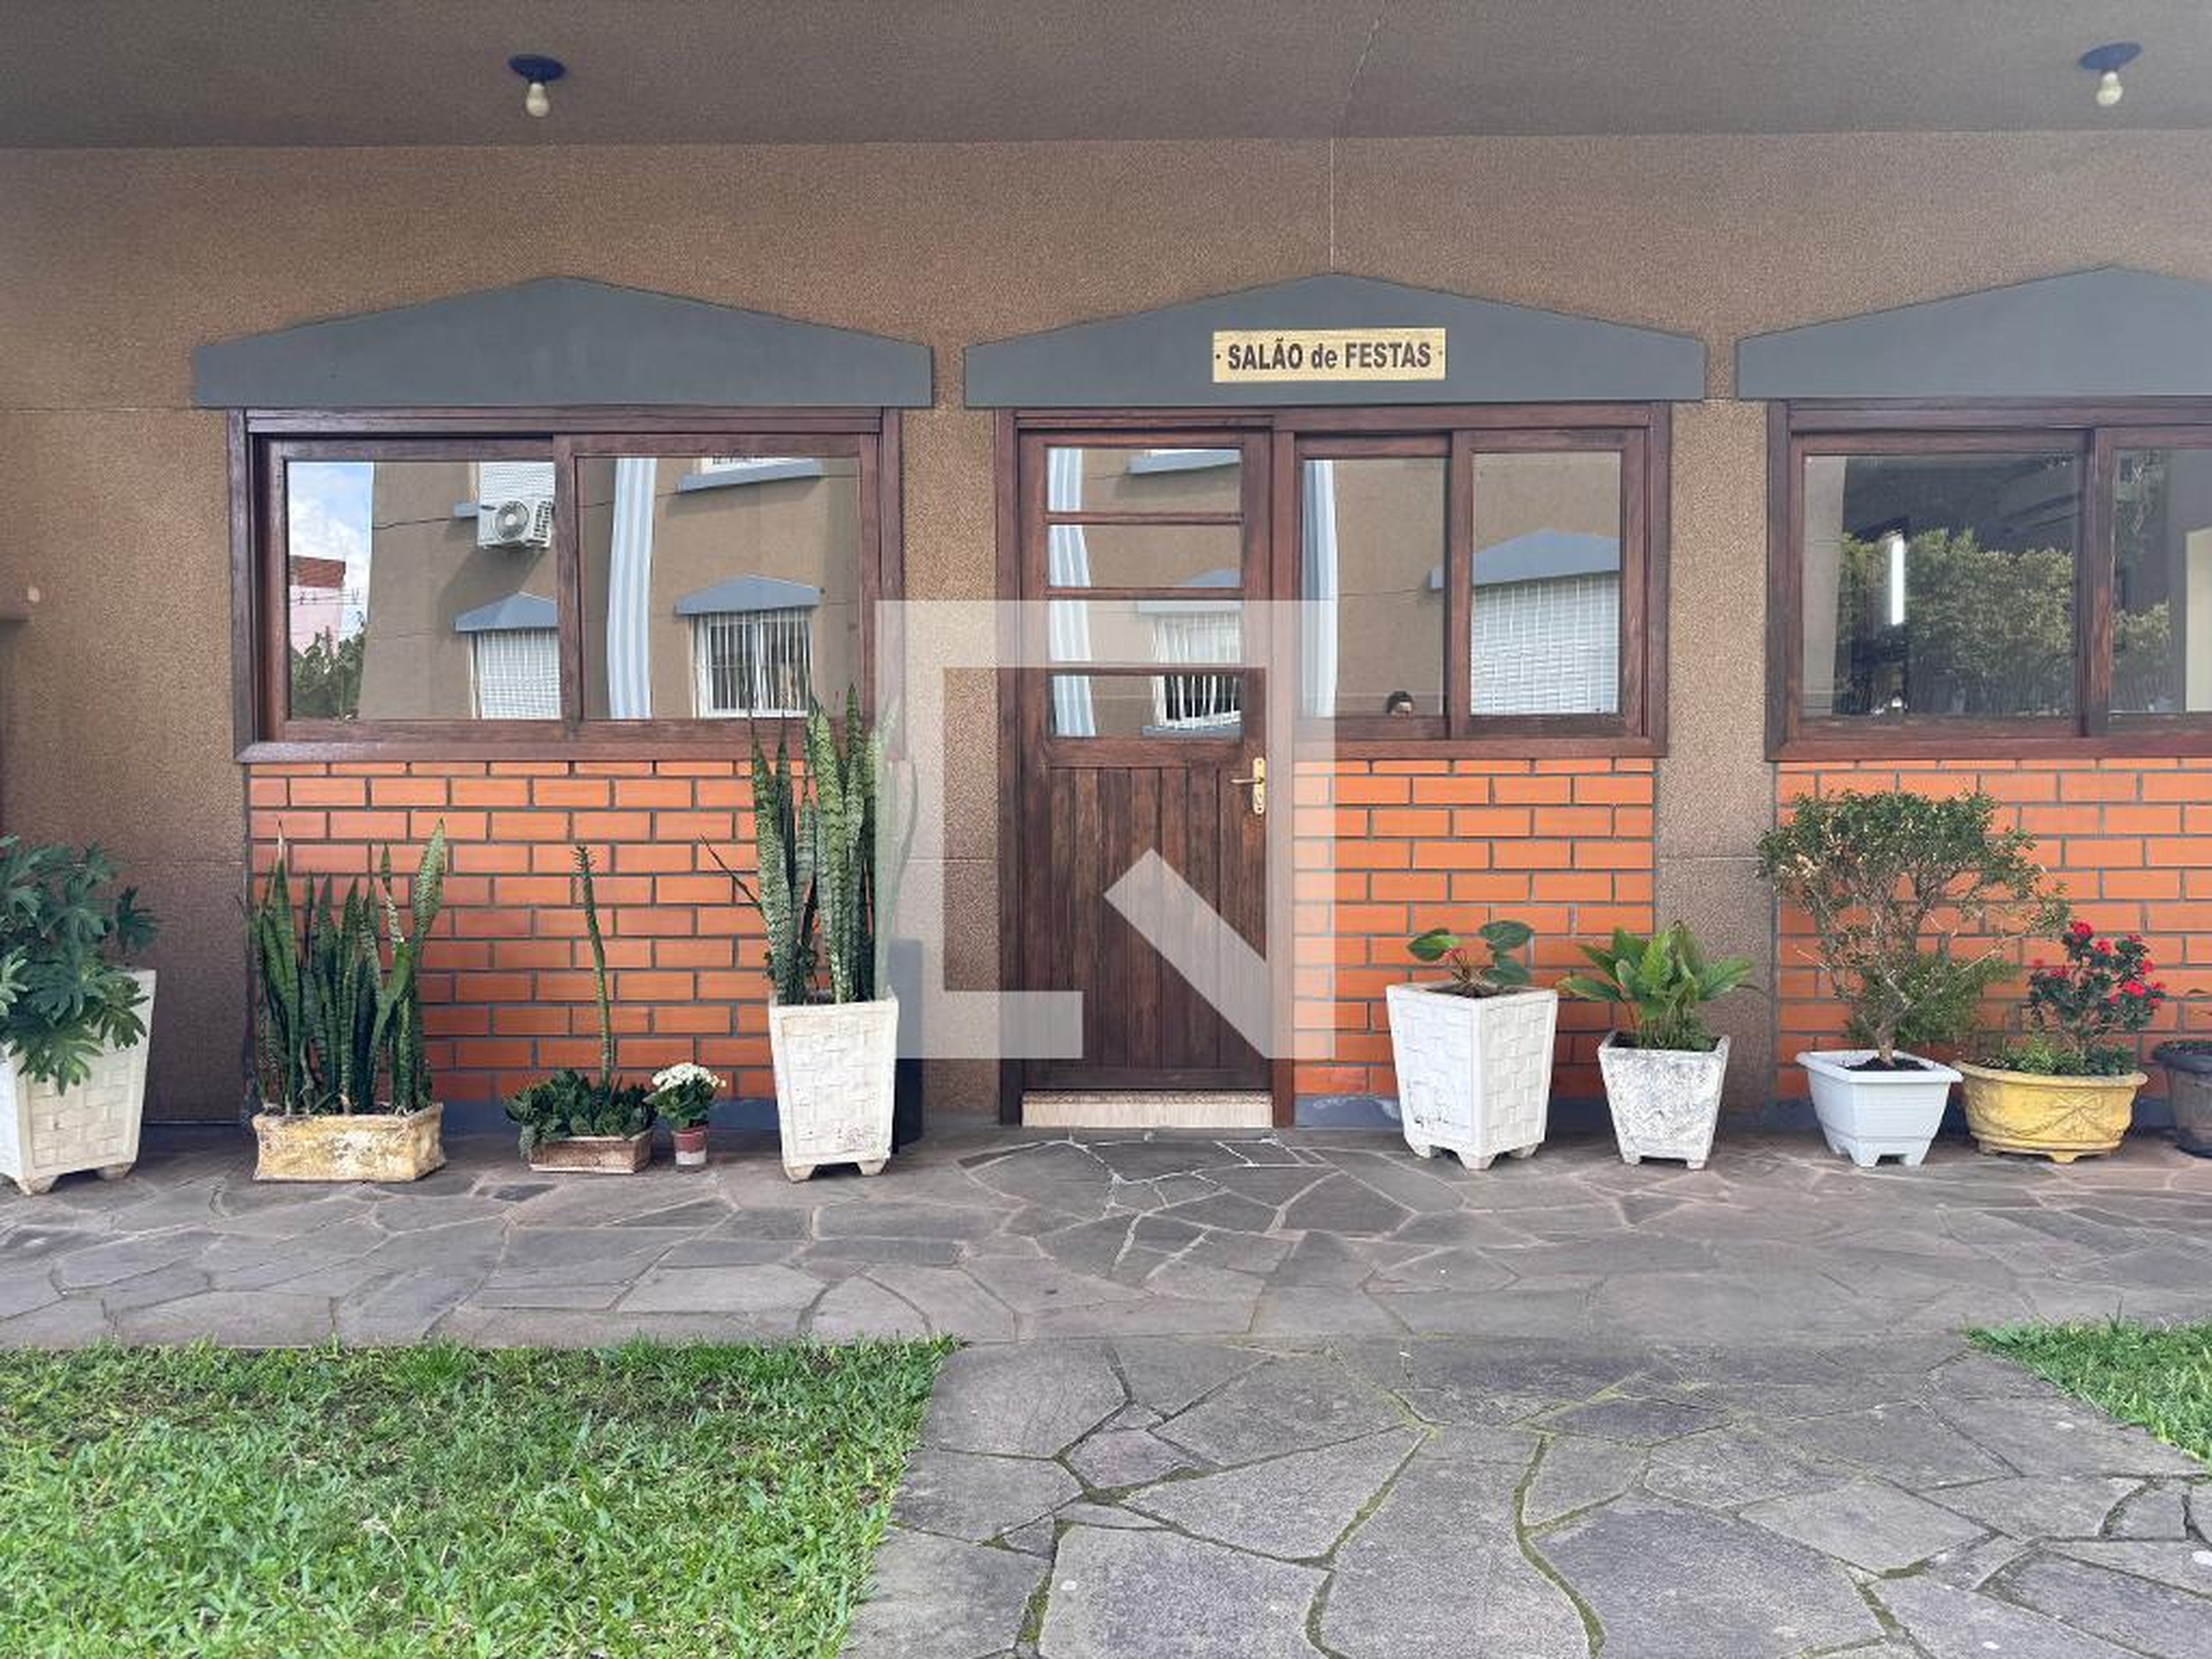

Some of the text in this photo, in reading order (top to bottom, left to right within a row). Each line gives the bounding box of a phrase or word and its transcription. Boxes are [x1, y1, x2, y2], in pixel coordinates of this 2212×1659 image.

[1228, 337, 1431, 370] SALÃO de FESTAS
